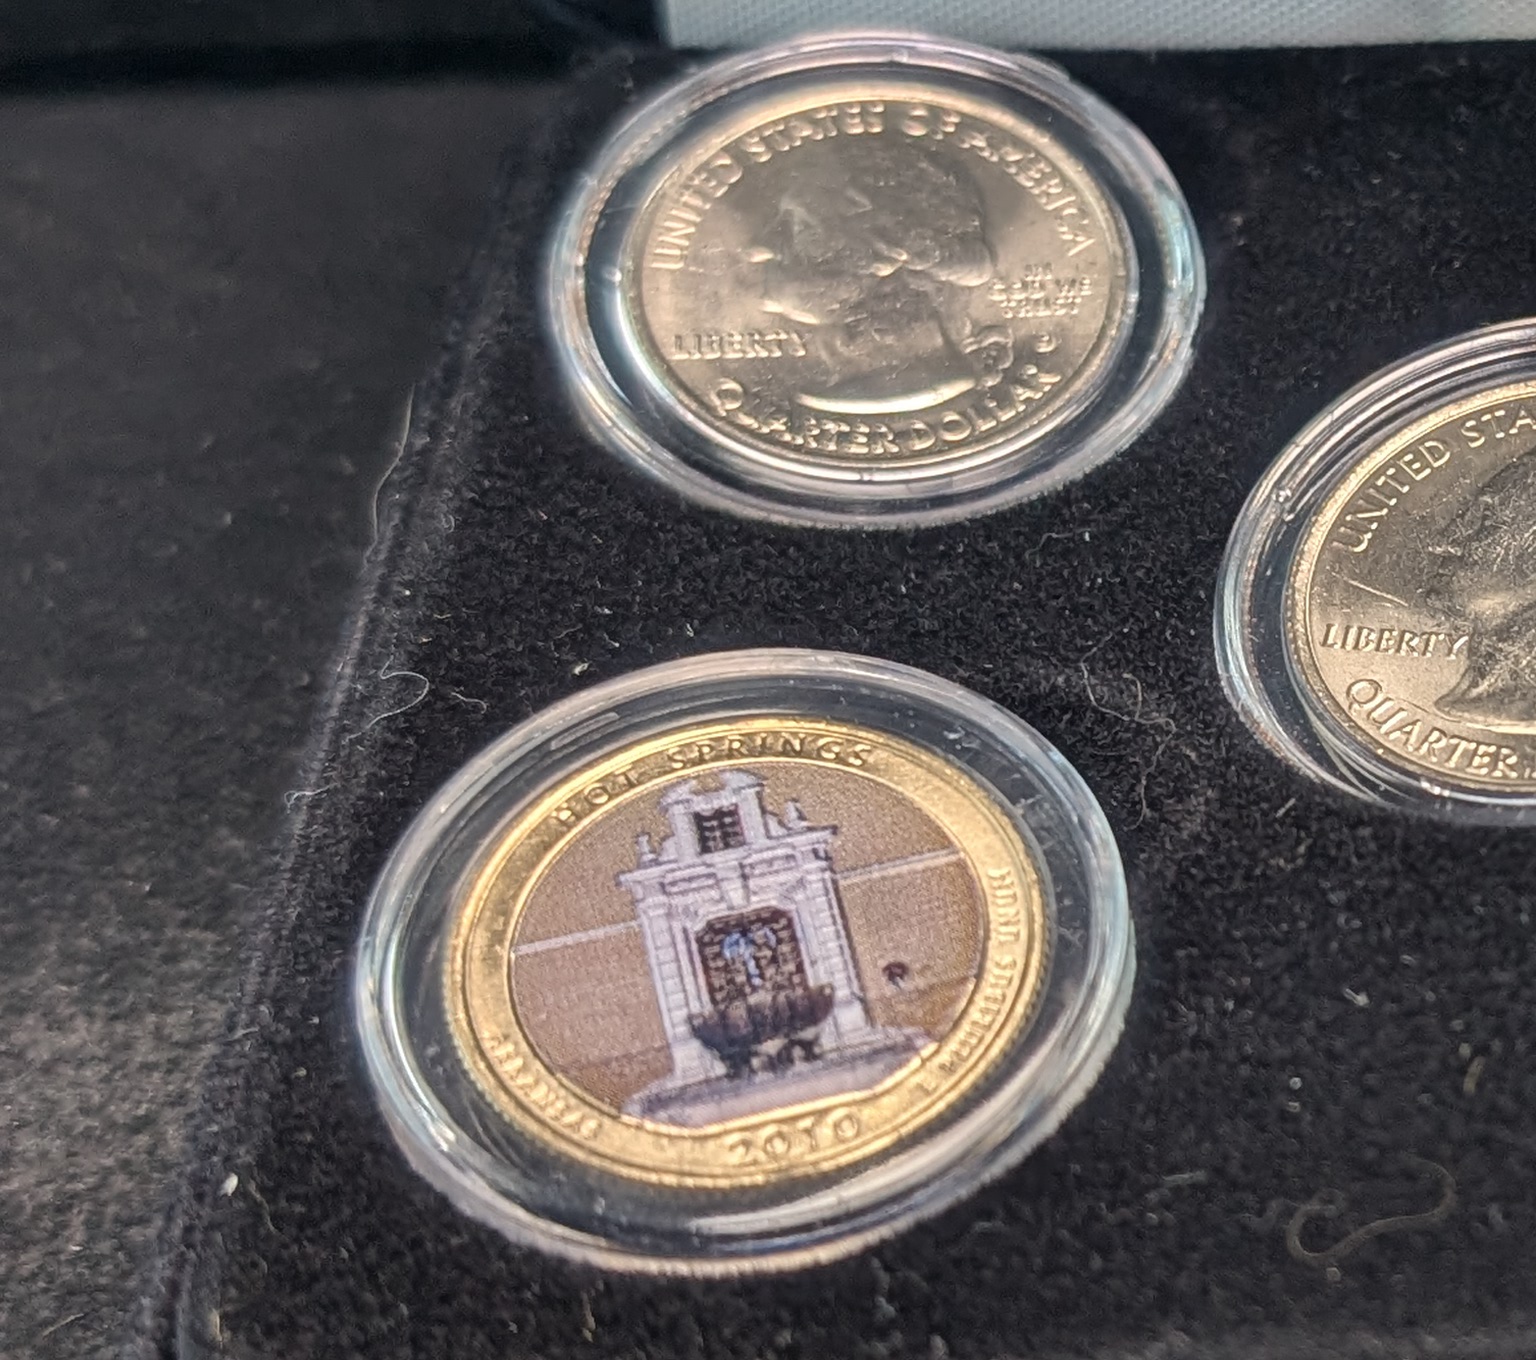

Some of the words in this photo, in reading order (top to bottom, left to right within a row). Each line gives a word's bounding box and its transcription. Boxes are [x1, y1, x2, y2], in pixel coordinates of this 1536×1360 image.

[650, 152, 742, 270] UNITED
[668, 330, 806, 360] LIBERTY
[1333, 439, 1451, 553] UNITED
[1319, 622, 1470, 661] LIBERTY
[1347, 679, 1519, 779] QUARTER
[551, 763, 639, 828] HOT
[667, 733, 872, 768] SPRINGS
